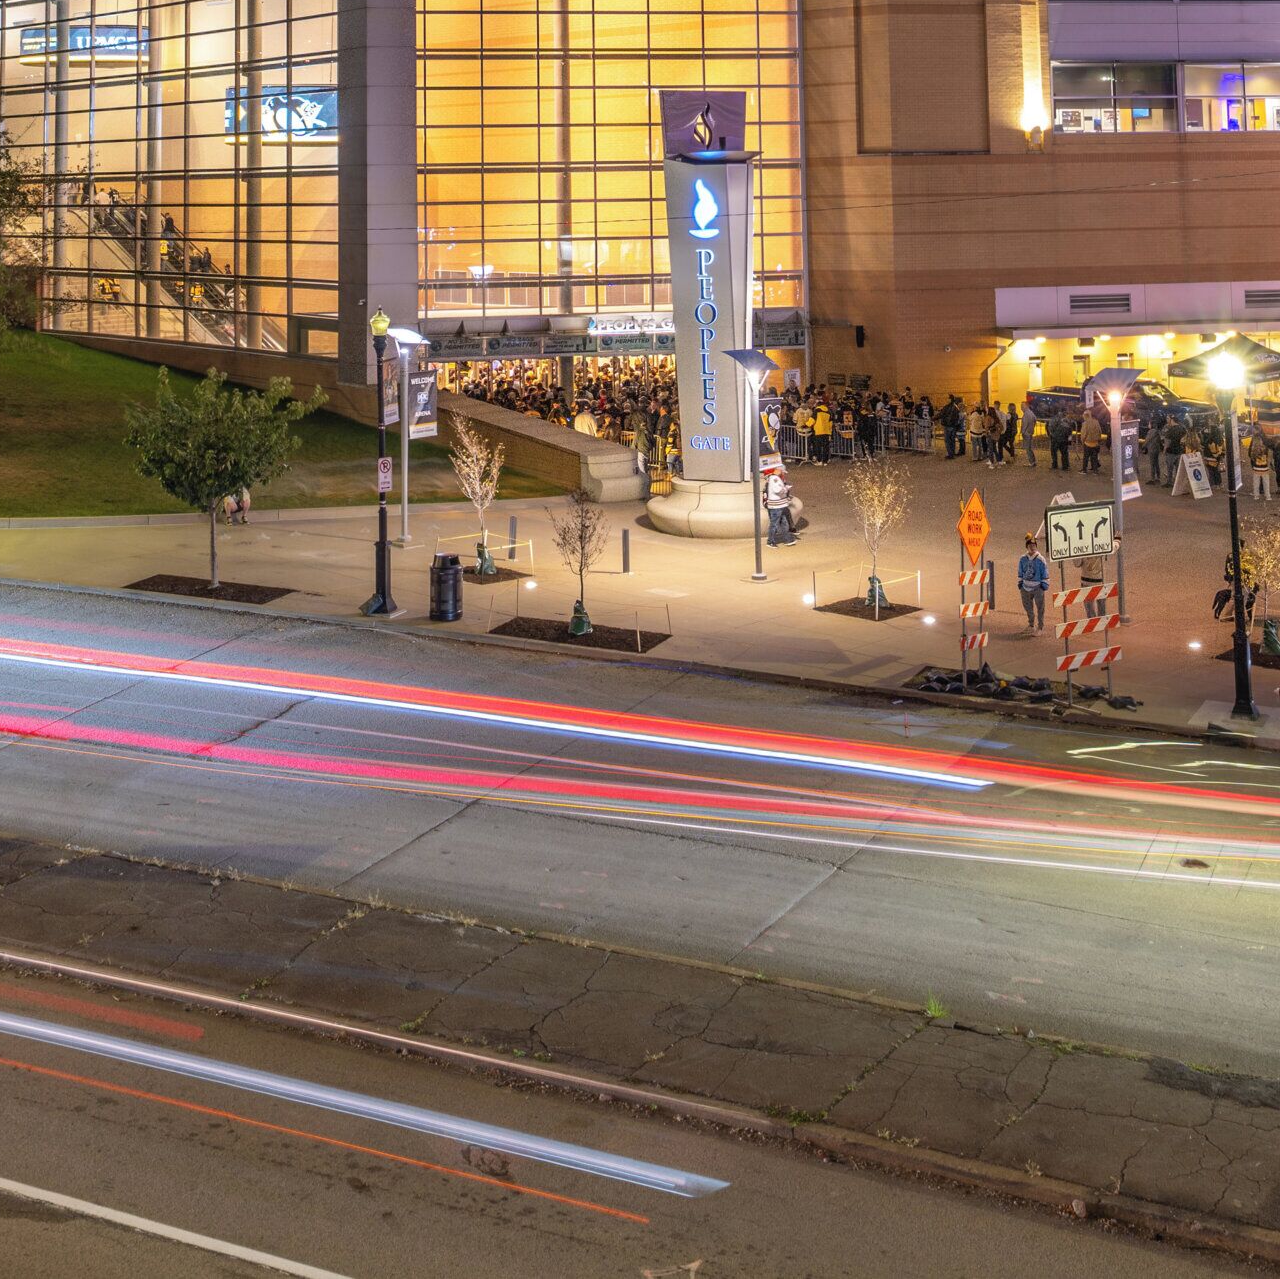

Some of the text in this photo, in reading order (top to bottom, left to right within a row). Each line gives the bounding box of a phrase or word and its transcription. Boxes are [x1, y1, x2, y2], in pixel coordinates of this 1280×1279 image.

[597, 319, 656, 332] PEOPLES
[694, 248, 719, 426] PEOPLES
[690, 435, 731, 451] GATE
[967, 510, 982, 522] ROAD
[967, 523, 982, 534] WORK
[1053, 542, 1110, 557] ONLY ONLY ONLY
